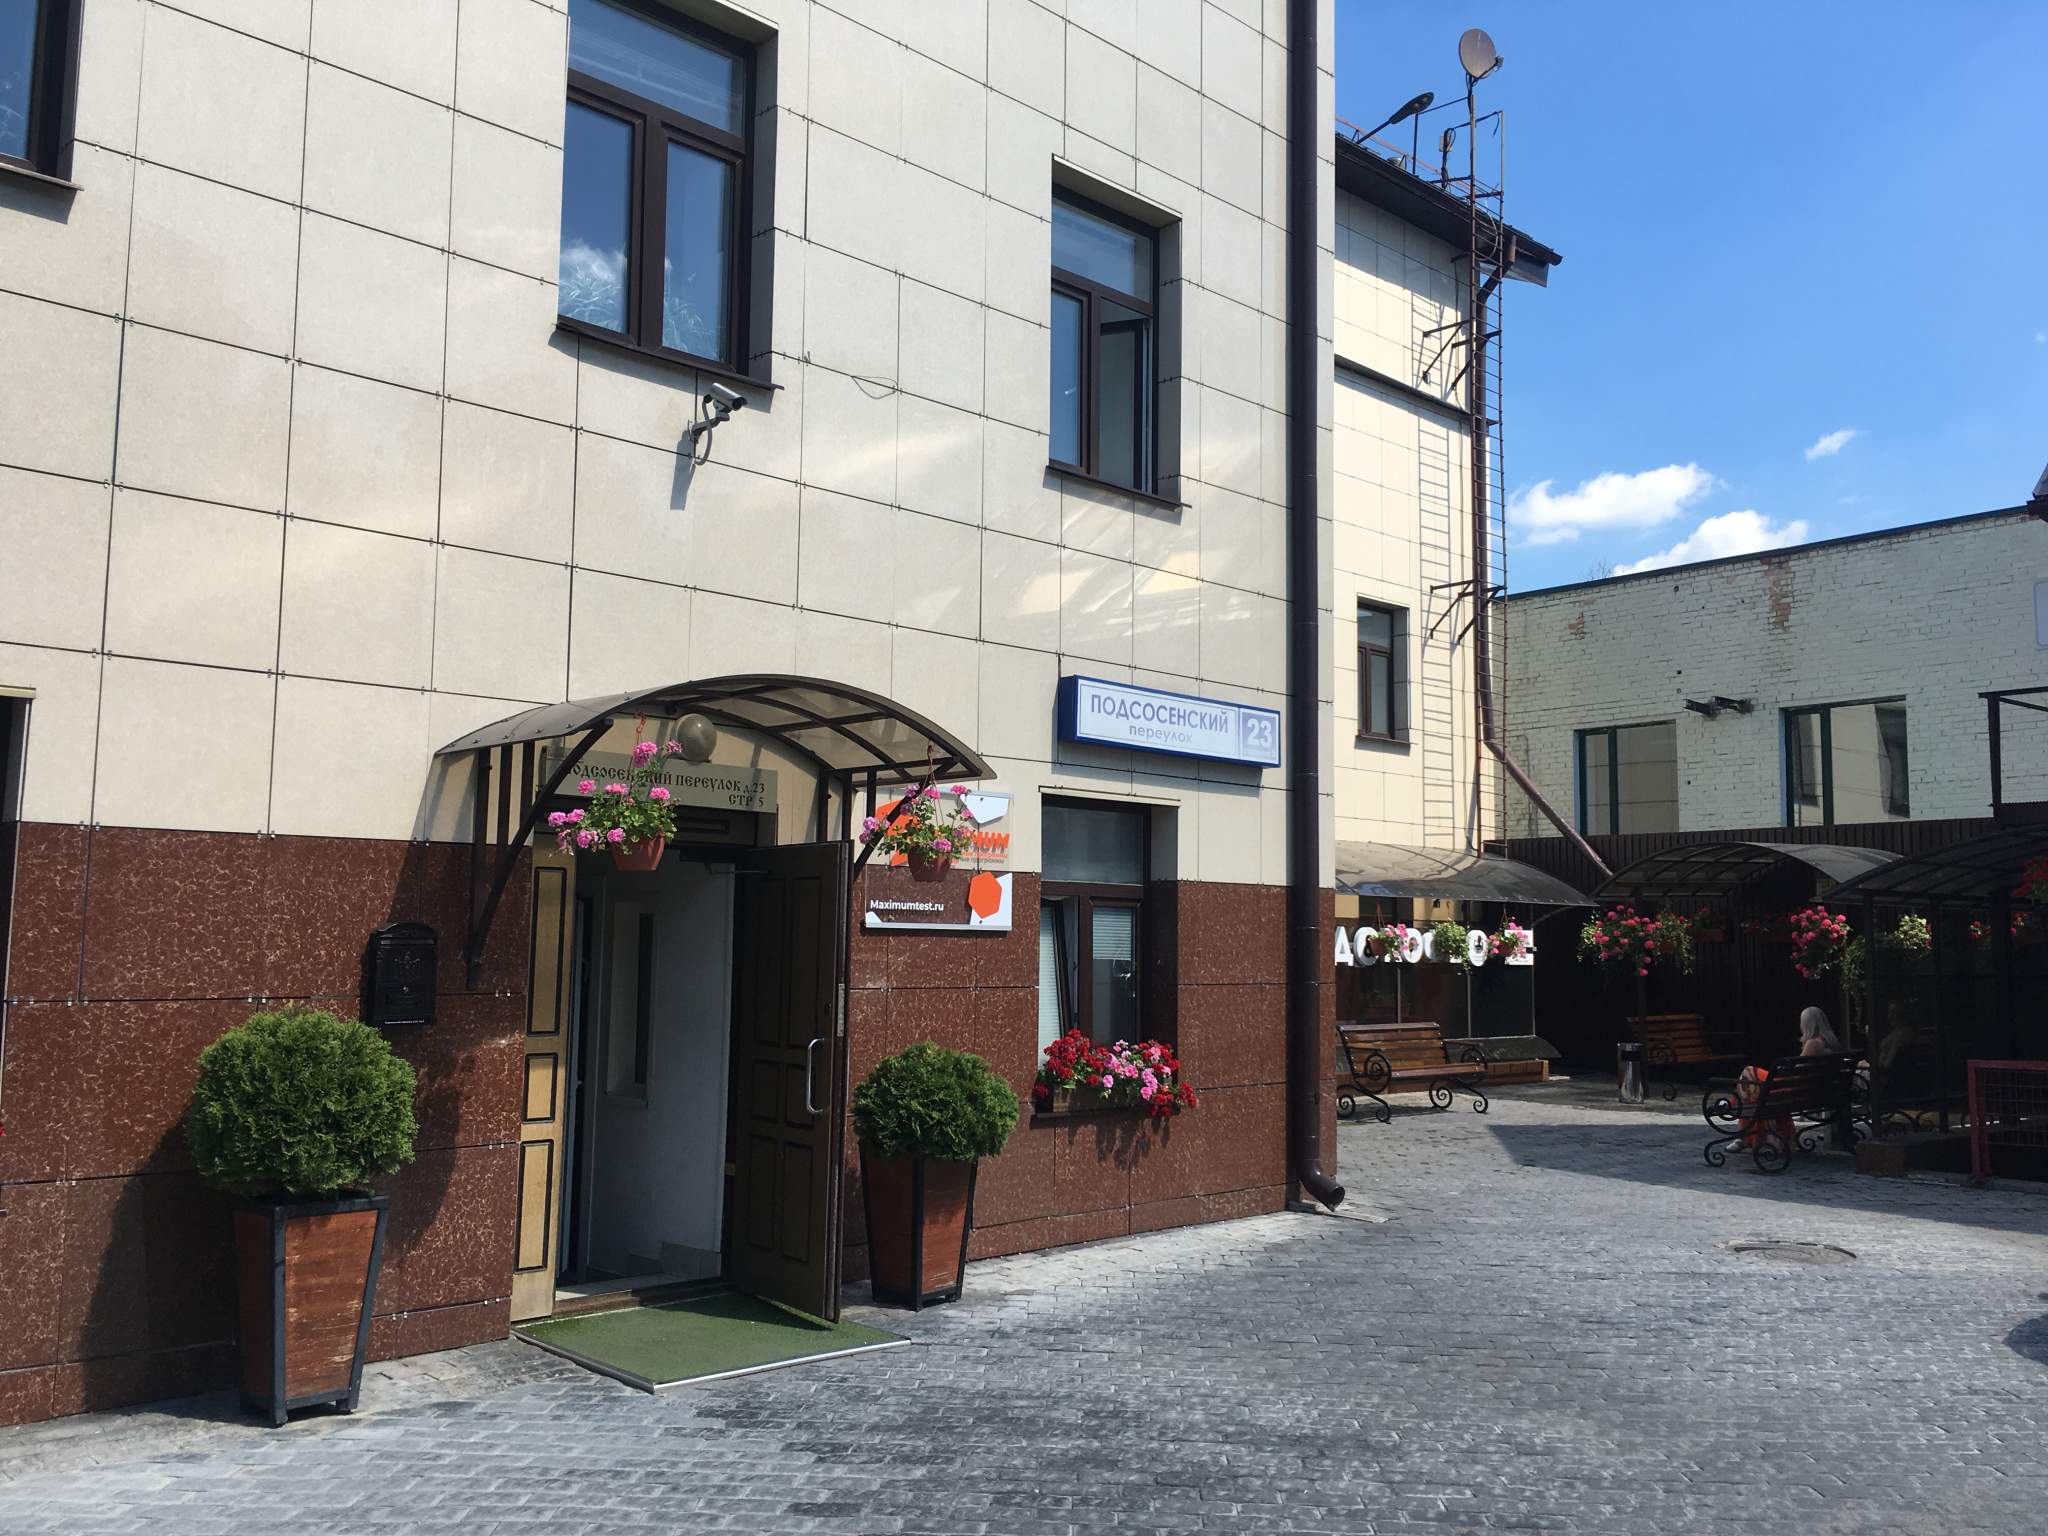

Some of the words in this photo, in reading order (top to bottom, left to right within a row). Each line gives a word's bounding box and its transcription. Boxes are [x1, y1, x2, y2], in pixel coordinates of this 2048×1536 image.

[1090, 694, 1229, 733] ПОДСОСЕНСКИЙ
[1129, 724, 1193, 744] переулок
[1246, 717, 1273, 747] 23
[675, 774, 742, 792] ПЕРЕУЛОК
[758, 797, 765, 808] 5
[870, 899, 944, 912] Maximumtest.ru
